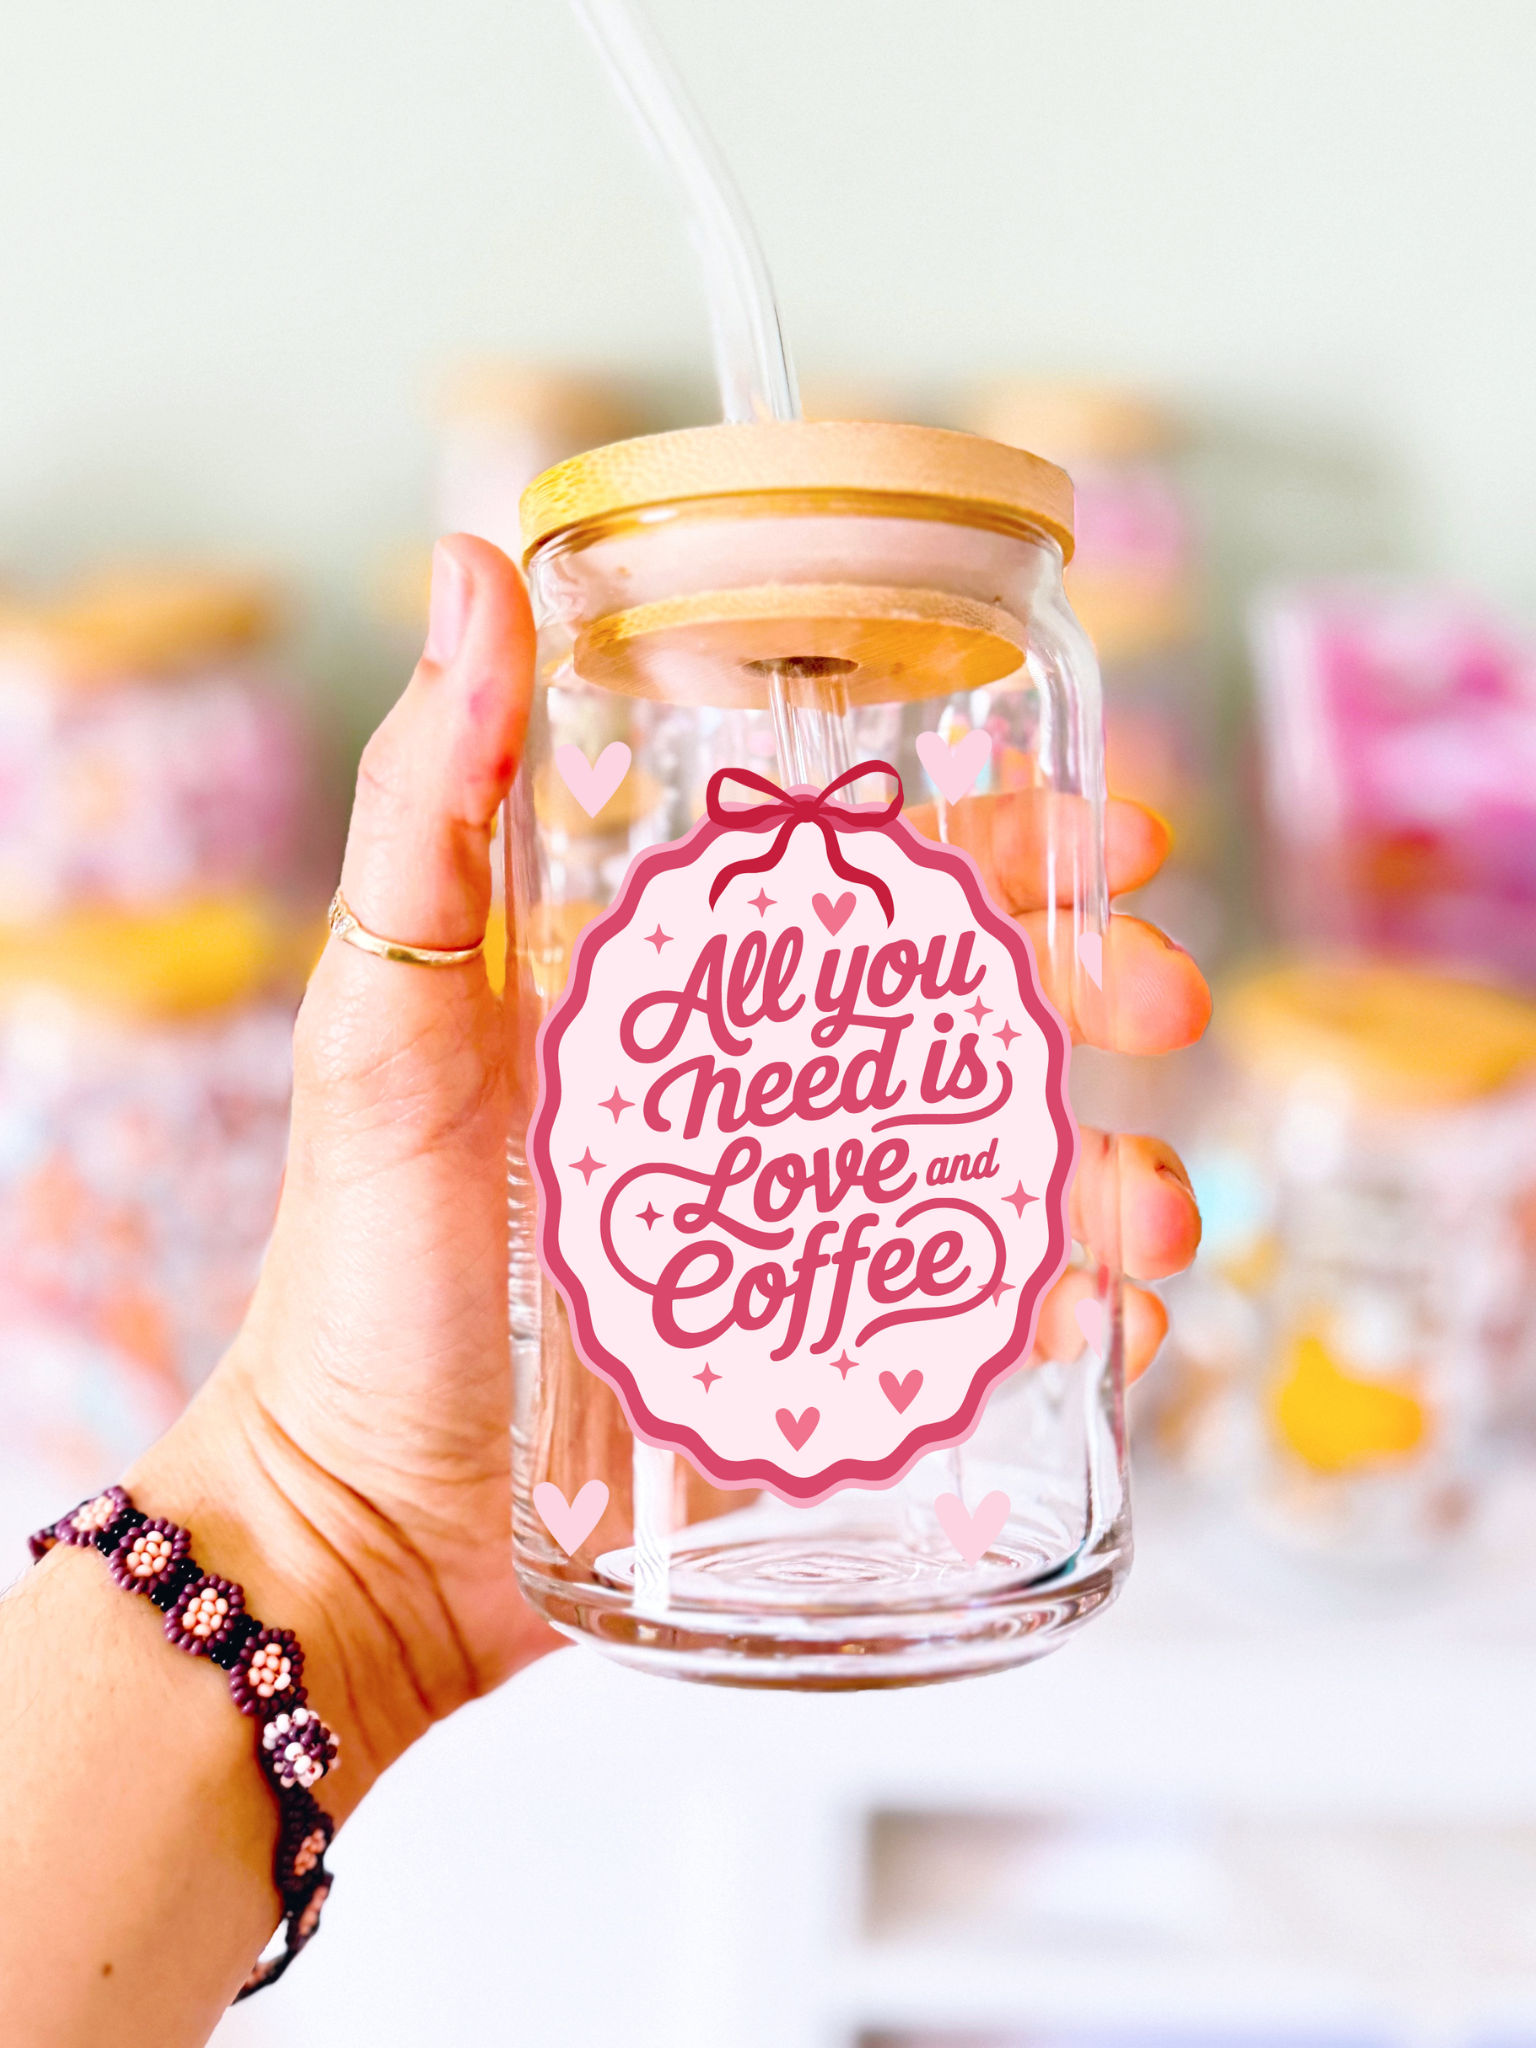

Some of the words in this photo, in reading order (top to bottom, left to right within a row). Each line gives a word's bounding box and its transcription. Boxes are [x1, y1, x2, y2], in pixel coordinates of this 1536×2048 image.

[619, 926, 806, 1064] All
[811, 930, 987, 1048] you
[920, 1012, 988, 1104] is
[673, 1136, 918, 1251] Love
[925, 1137, 1000, 1187] and
[652, 1212, 972, 1362] Coffee
